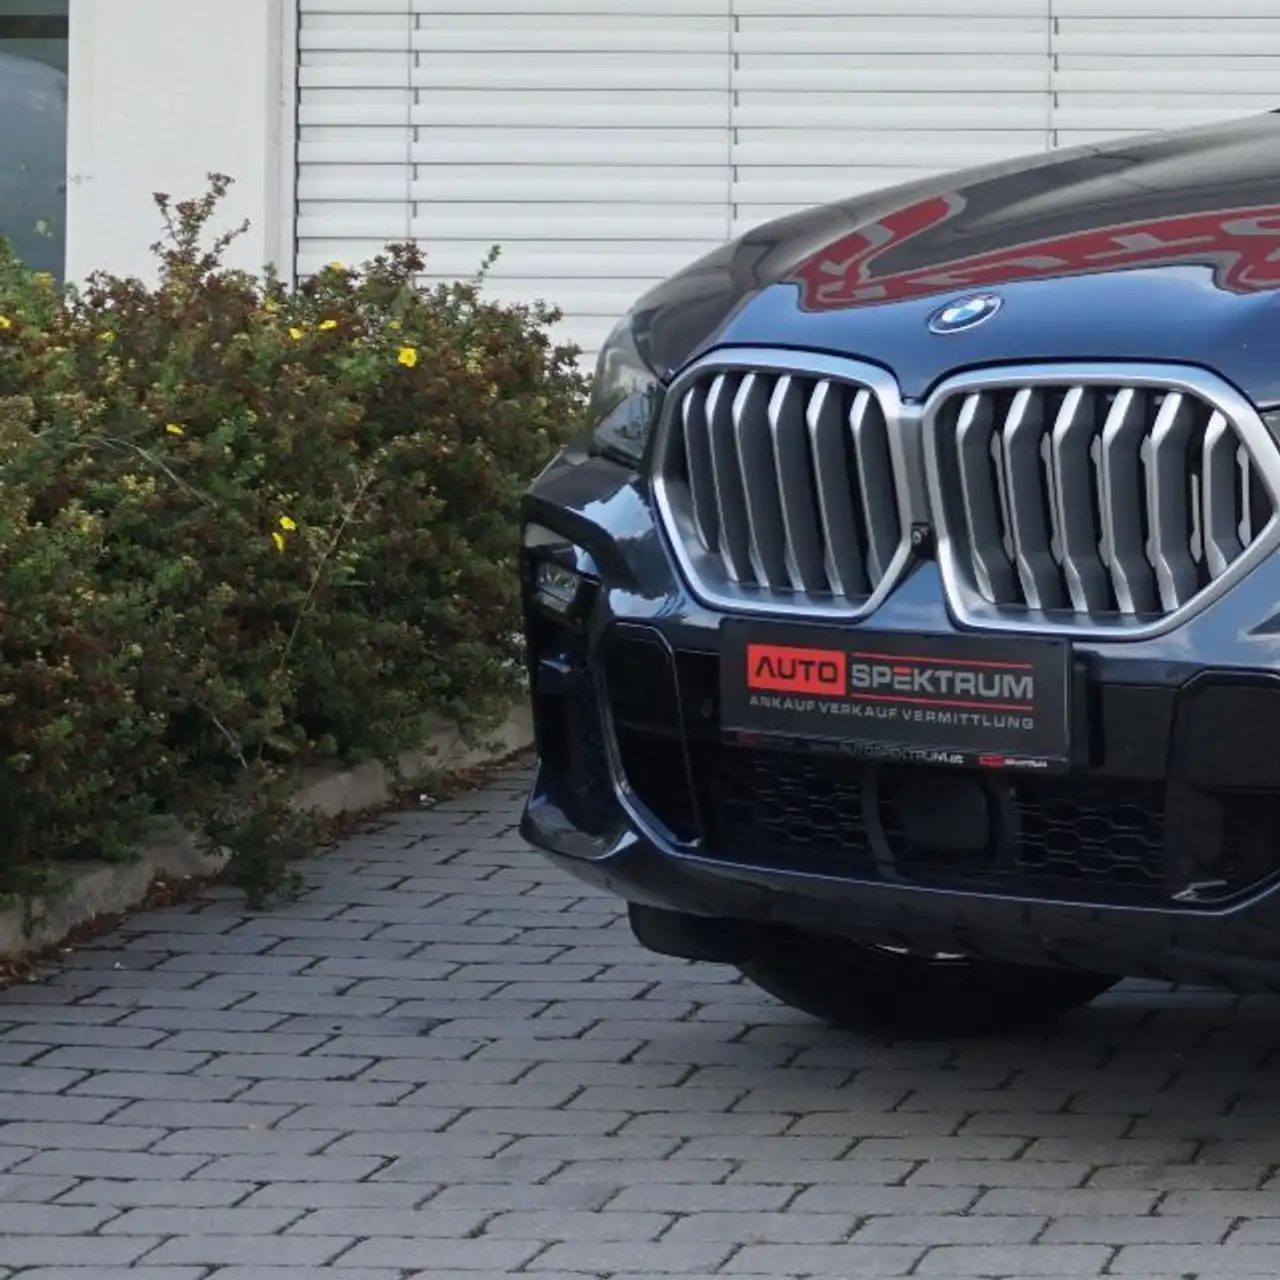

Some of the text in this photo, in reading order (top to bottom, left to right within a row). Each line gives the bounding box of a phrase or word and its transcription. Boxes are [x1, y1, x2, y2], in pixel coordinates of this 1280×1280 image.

[754, 655, 1035, 700] AUTO SPEKTRUM
[749, 695, 1035, 730] ANKAUF VERKAUF VERMITTLUNG
